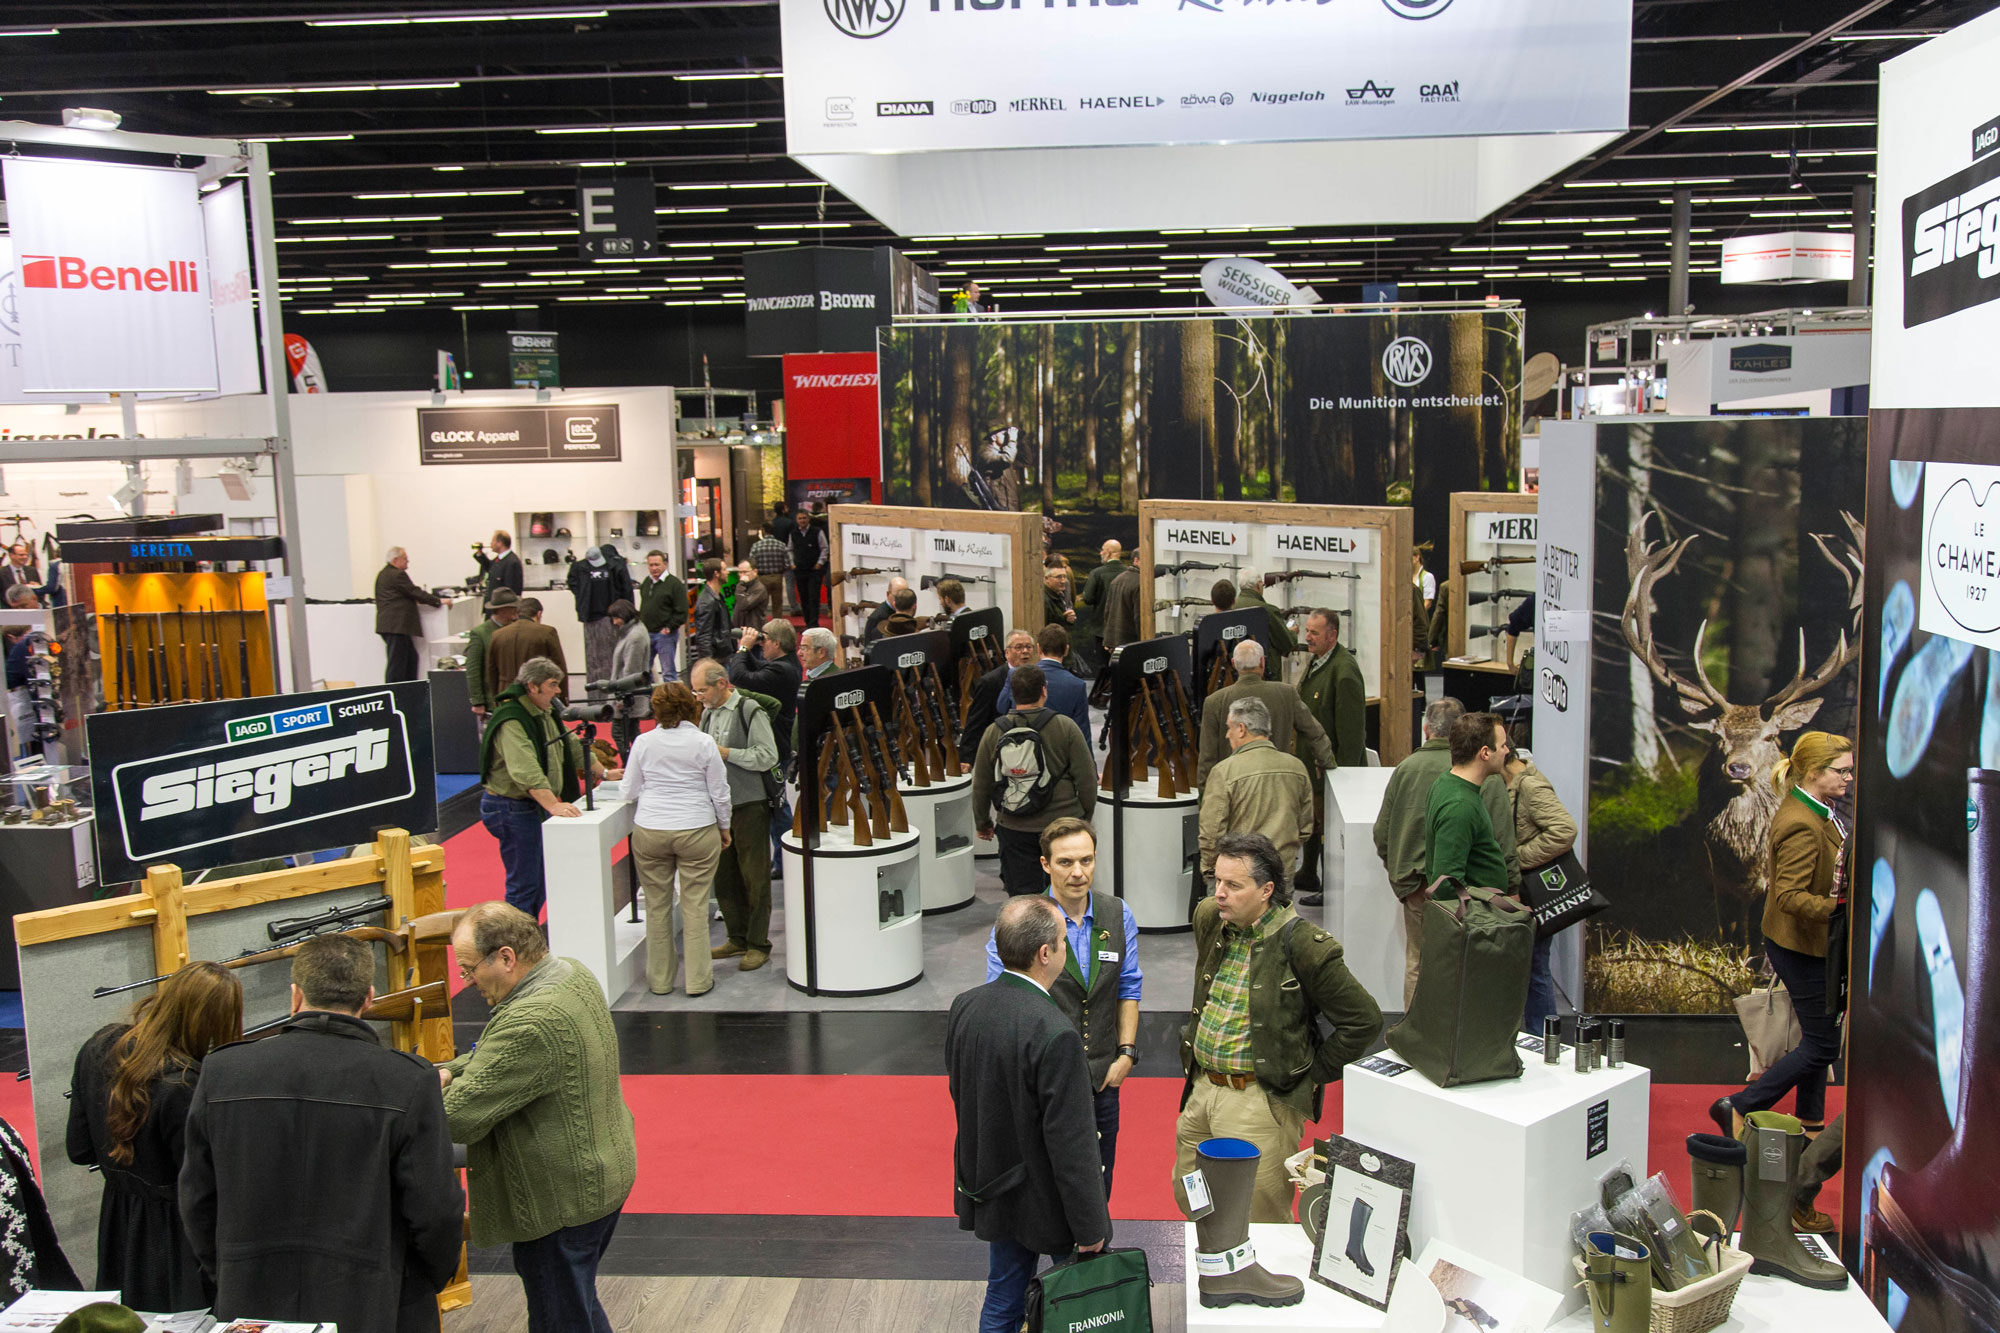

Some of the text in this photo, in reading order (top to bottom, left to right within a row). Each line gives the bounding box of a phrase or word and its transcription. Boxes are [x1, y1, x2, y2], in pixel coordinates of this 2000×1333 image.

[1250, 91, 1326, 105] Niggeloh
[1419, 84, 1453, 97] CAA
[880, 103, 930, 114] DIANA
[1009, 98, 1068, 112] MERKEL
[1080, 96, 1154, 109] HAENEL
[1974, 126, 1998, 152] JAGD
[582, 187, 617, 232] E
[58, 256, 199, 293] Benelli
[1217, 278, 1277, 306] WILDKAM
[1222, 265, 1291, 305] SEISSIGER
[747, 294, 815, 312] WINCHESTER
[1387, 341, 1427, 384] RWS
[1733, 359, 1789, 369] KAHLES
[1309, 394, 1504, 410] Die Munition entscheidet.
[431, 430, 520, 444] GLOCK Apparel
[807, 490, 842, 498] POINT
[851, 532, 871, 545] TITAN
[1167, 528, 1231, 546] HAENEL
[1974, 522, 1985, 537] LE
[130, 543, 193, 557] BERETTA
[934, 538, 956, 552] TITAN
[1277, 533, 1350, 554] HAENEL
[1543, 543, 1579, 579] A BETTER
[1937, 542, 2000, 579] CHAME
[1543, 571, 1563, 602] VIEW
[1966, 584, 1987, 602] 1927
[235, 700, 384, 738] JAGD SPORT SCHUTZ
[140, 728, 389, 822] Siegert
[1068, 1309, 1125, 1333] FRANKONIA
